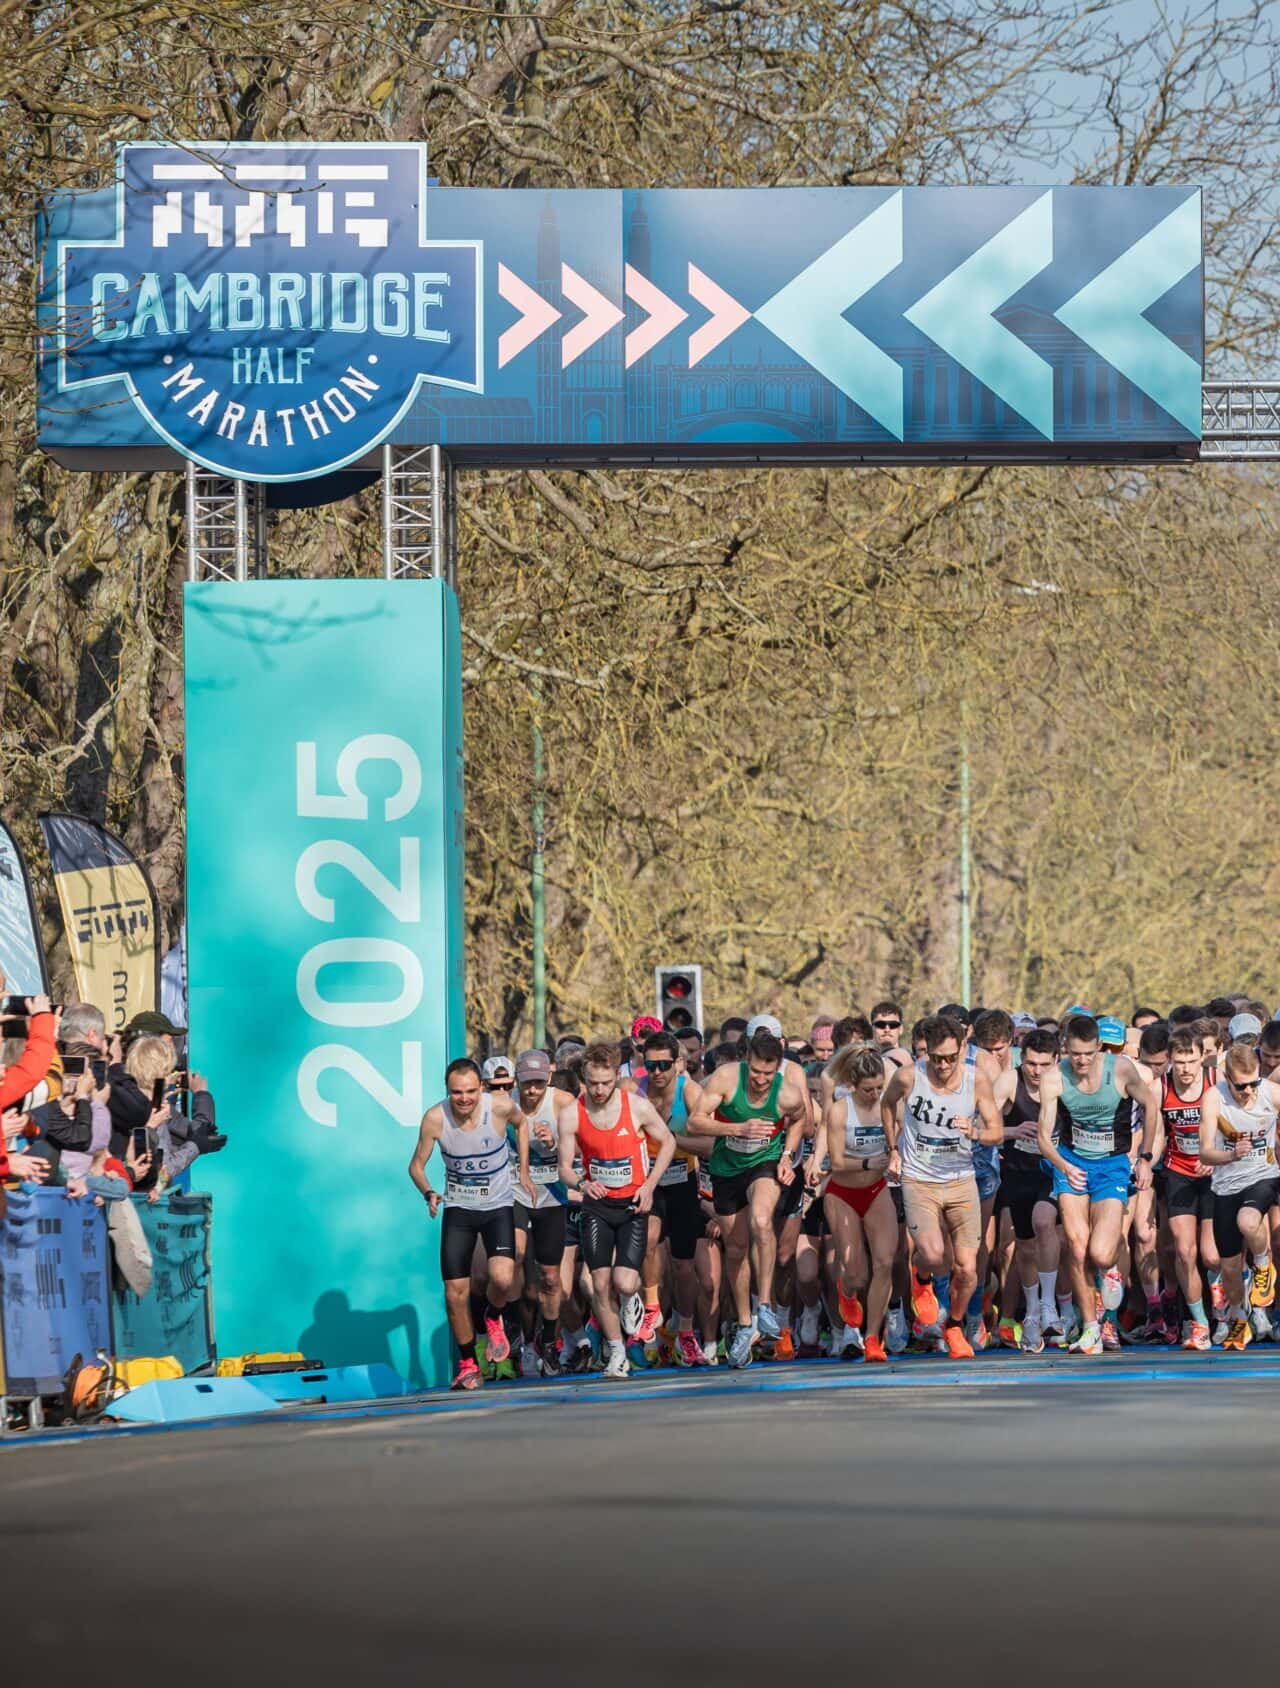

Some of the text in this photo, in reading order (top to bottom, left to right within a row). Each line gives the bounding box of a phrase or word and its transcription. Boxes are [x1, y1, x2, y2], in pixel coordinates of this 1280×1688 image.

[91, 271, 452, 343] CAMBRIDGE
[161, 362, 381, 447] MARATHON
[232, 347, 314, 385] HALF
[295, 733, 424, 1128] 2025
